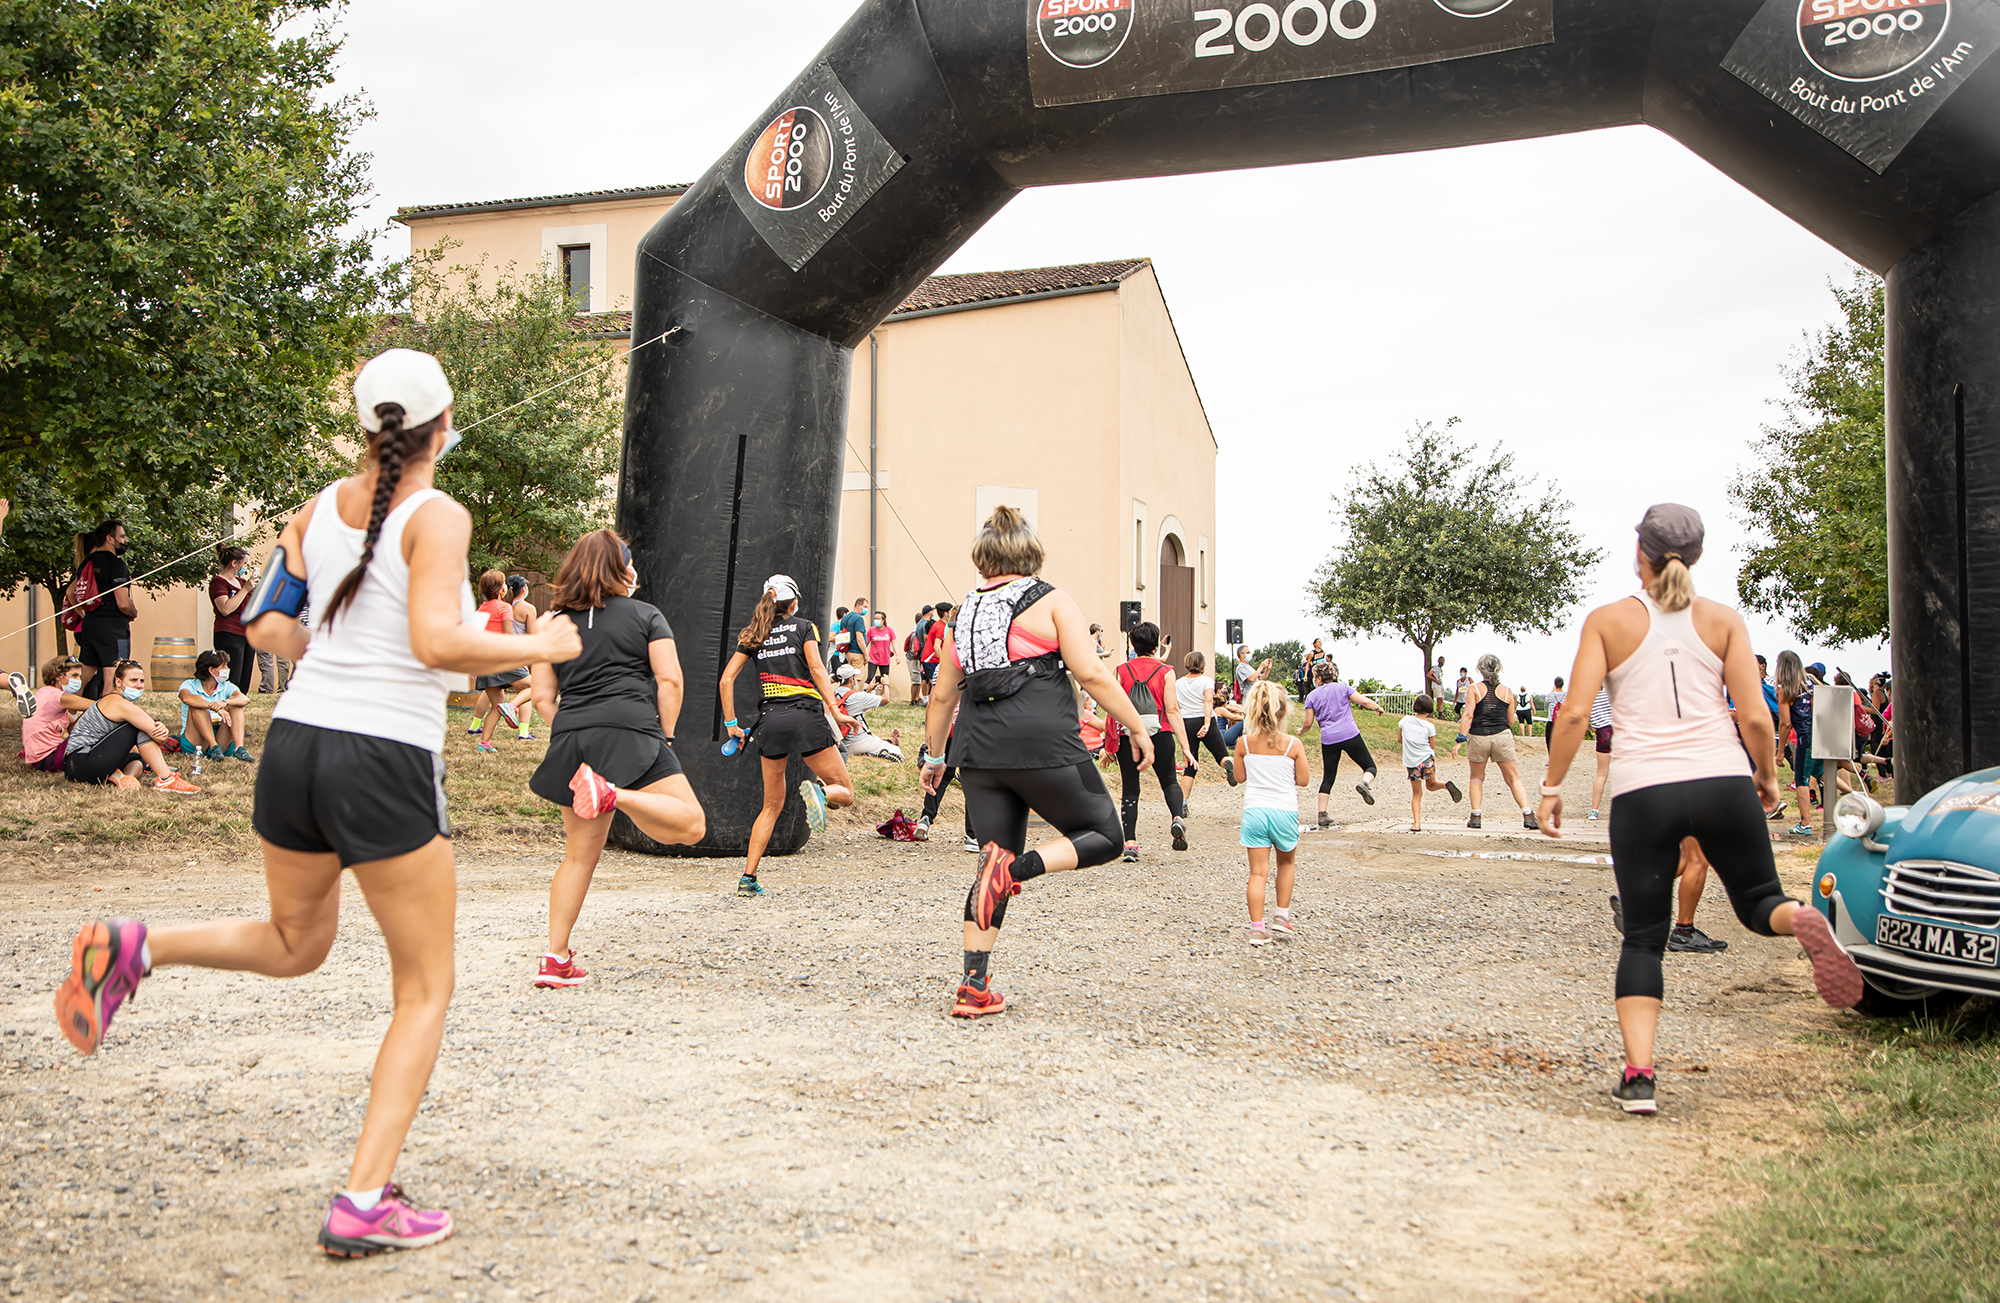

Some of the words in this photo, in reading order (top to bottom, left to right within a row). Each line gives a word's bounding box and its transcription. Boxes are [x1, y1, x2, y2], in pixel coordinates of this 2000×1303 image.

[1811, 0, 1927, 21] SPO
[1053, 12, 1117, 37] 2000
[1194, 0, 1377, 58] 2000
[1824, 9, 1924, 47] 2000
[1789, 77, 1830, 110] Bout
[1830, 95, 1856, 114] du
[1860, 89, 1907, 113] Pont
[1908, 75, 1936, 97] de
[838, 116, 853, 135] de
[765, 119, 792, 199] SPORT
[785, 123, 807, 192] 2000
[843, 136, 857, 171] Pont
[838, 173, 854, 194] du
[817, 193, 847, 223] Bout
[1016, 589, 1040, 613] IKE
[763, 634, 788, 646] club
[770, 623, 797, 634] ning
[757, 646, 796, 660] élusate
[1878, 917, 1921, 950] 8224
[1924, 926, 1956, 957] MA
[1961, 932, 1996, 963] 32
